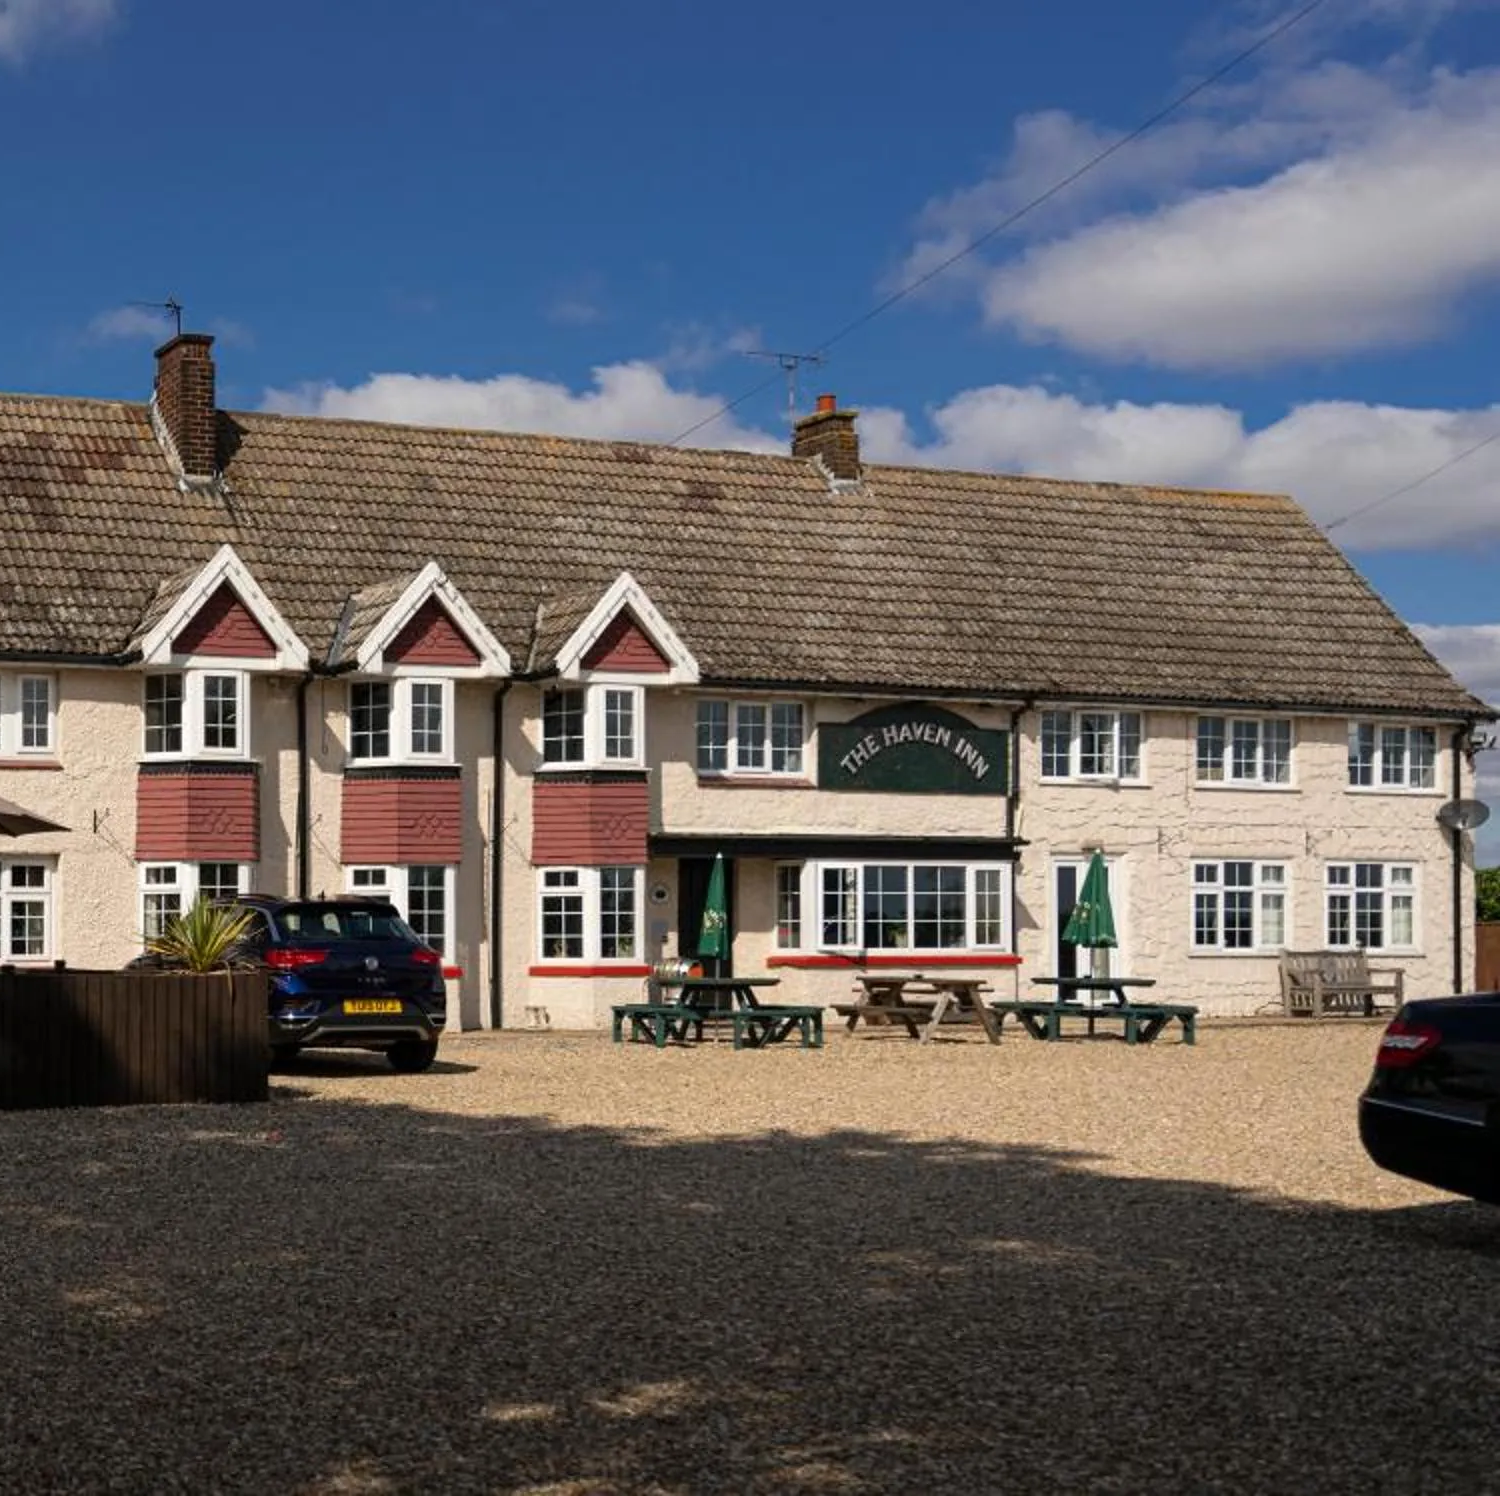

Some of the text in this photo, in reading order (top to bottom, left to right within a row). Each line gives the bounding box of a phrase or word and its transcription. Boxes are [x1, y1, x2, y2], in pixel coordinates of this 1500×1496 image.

[840, 721, 990, 779] THE HAVEN INN
